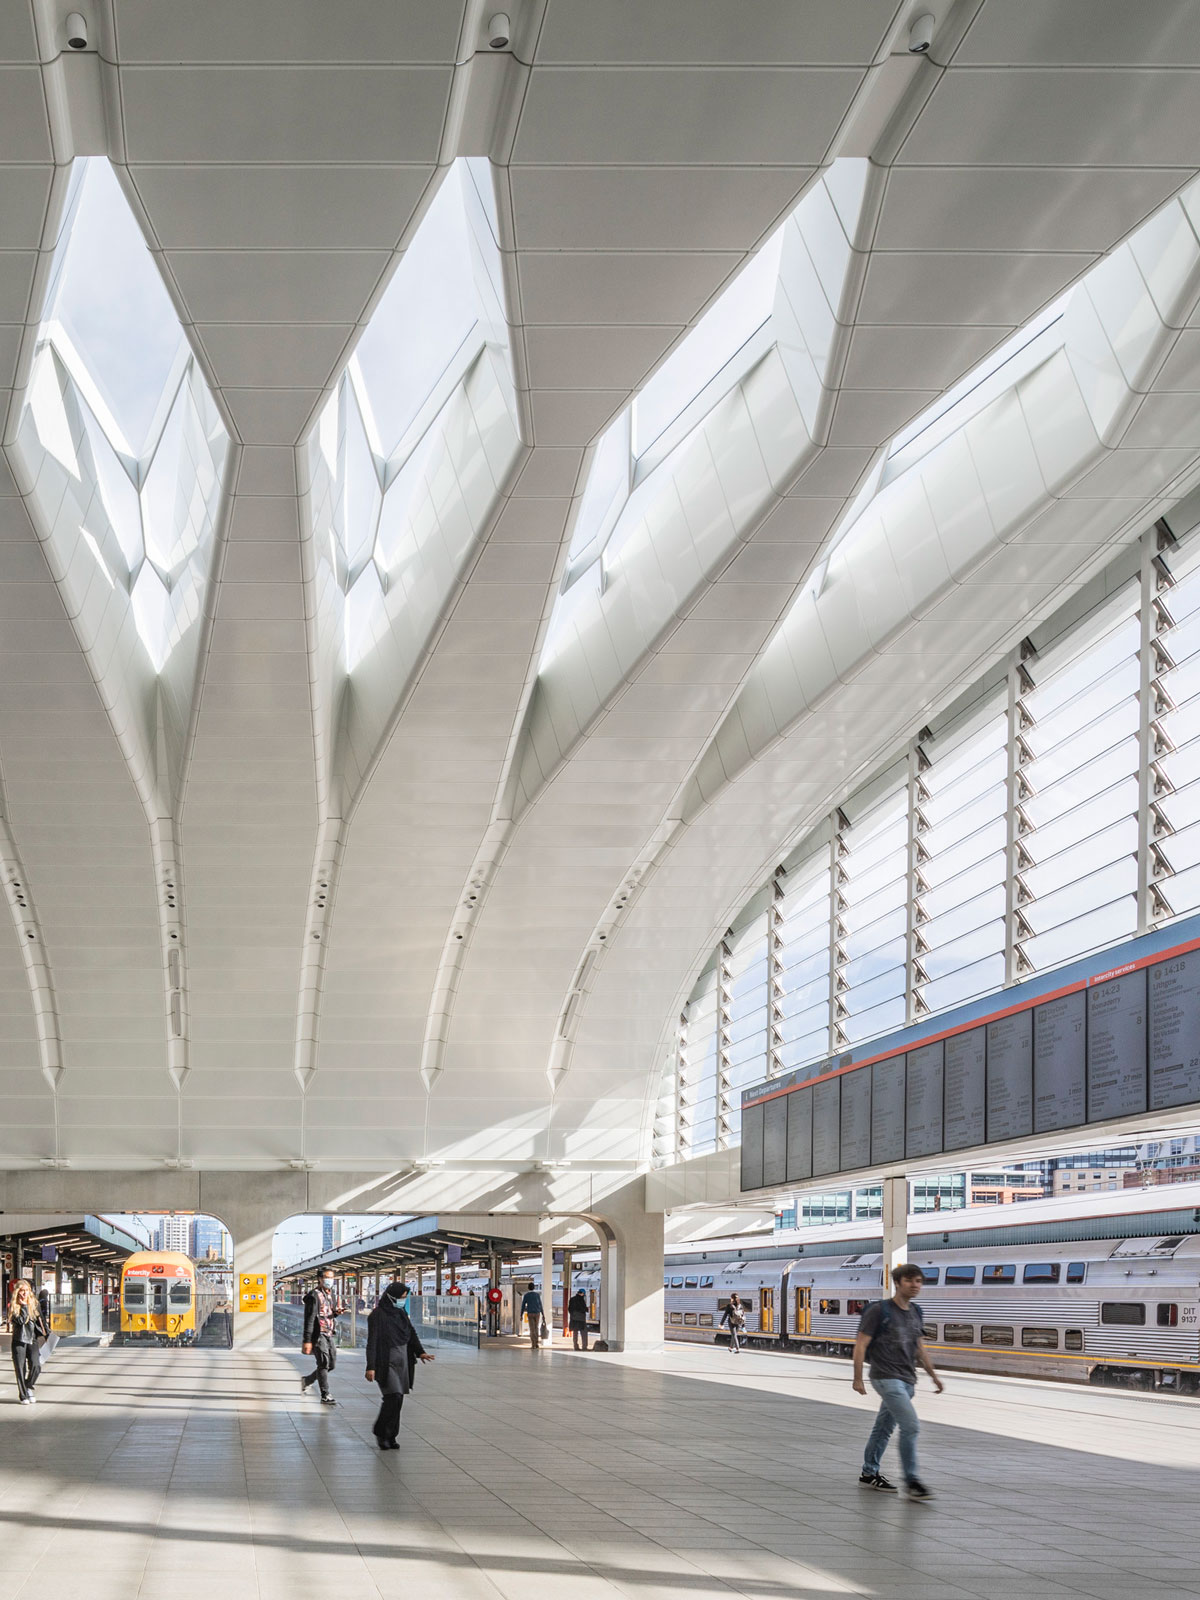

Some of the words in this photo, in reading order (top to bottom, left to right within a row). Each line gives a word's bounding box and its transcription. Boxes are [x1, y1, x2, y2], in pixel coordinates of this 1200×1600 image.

[1094, 971, 1114, 983] Intercity
[1115, 964, 1136, 975] services
[1164, 962, 1185, 976] 14:18
[1101, 984, 1120, 997] 14:23
[1136, 1016, 1142, 1025] 8
[127, 1269, 150, 1277] Intercity
[1181, 1315, 1197, 1323] 9137
